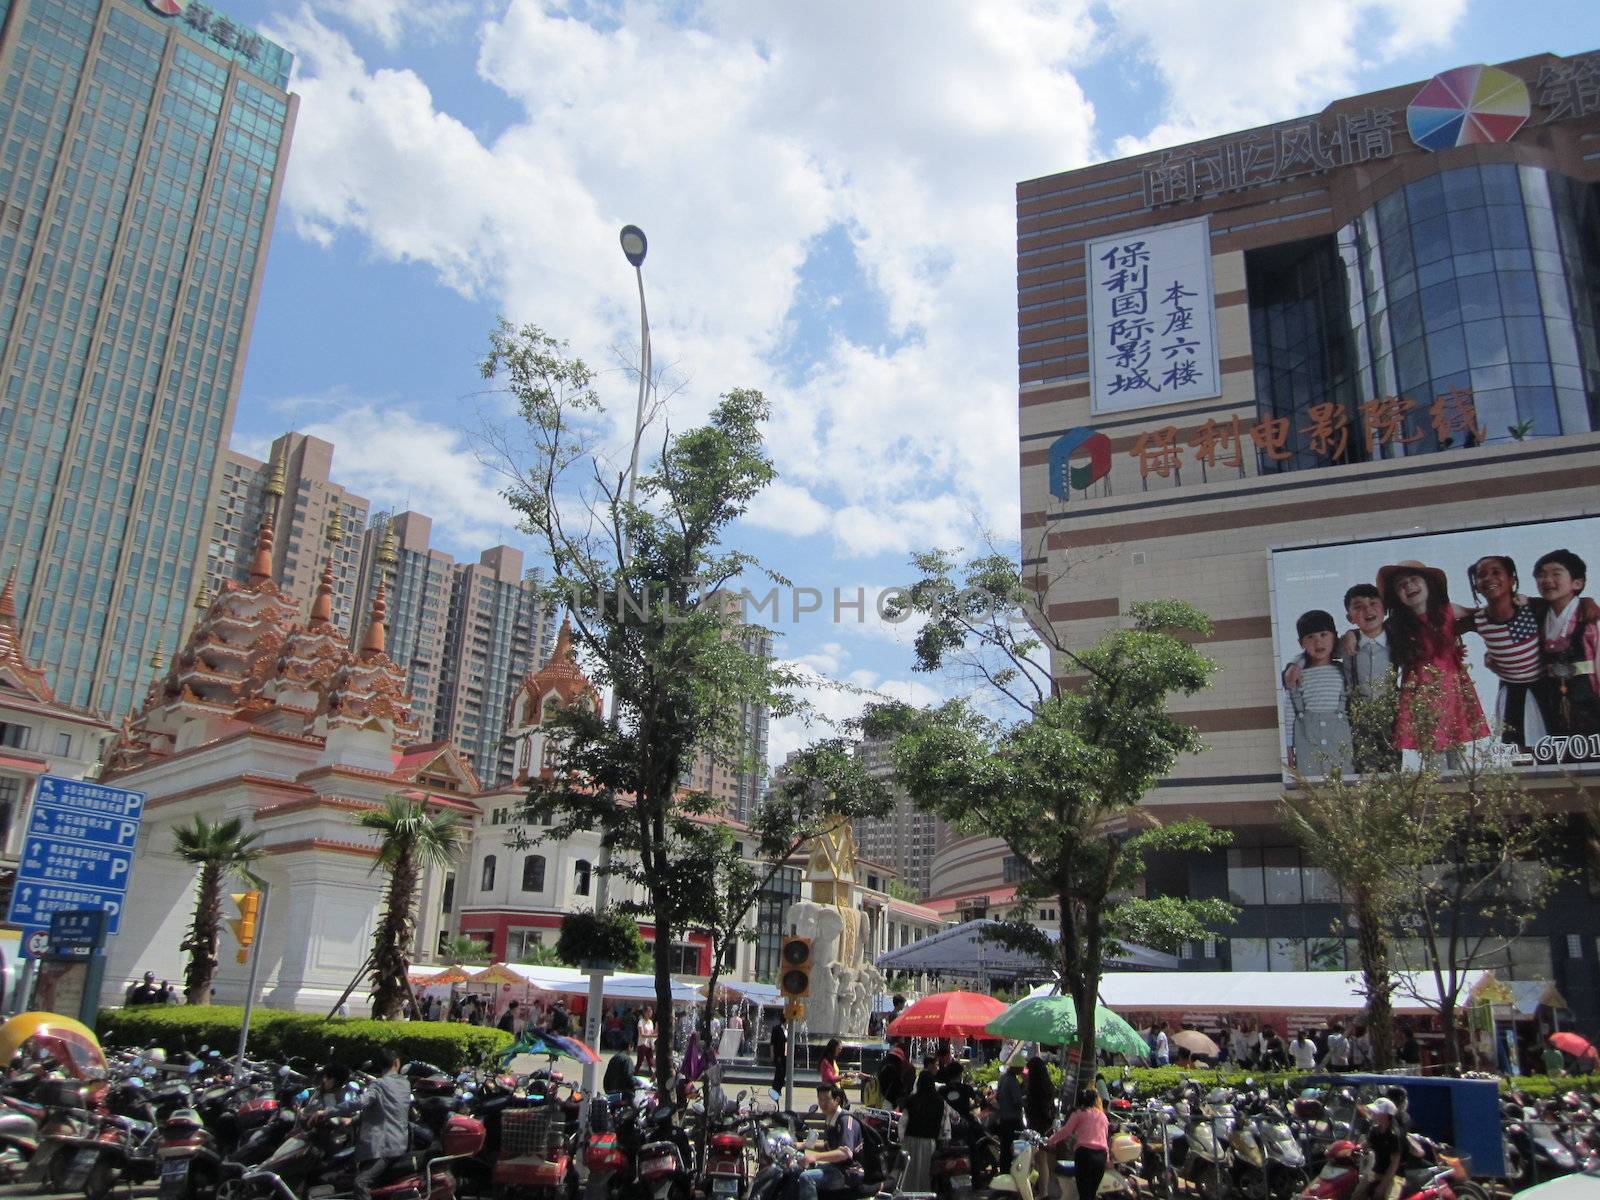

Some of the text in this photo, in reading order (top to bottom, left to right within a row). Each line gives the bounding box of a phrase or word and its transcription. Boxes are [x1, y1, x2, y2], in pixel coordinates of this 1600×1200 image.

[1139, 107, 1398, 208] 南亚风情
[1099, 241, 1161, 395] 保利国际影城
[1159, 280, 1203, 390] 本座六楼
[117, 822, 136, 844] P
[124, 793, 142, 815] P
[109, 858, 128, 880] P
